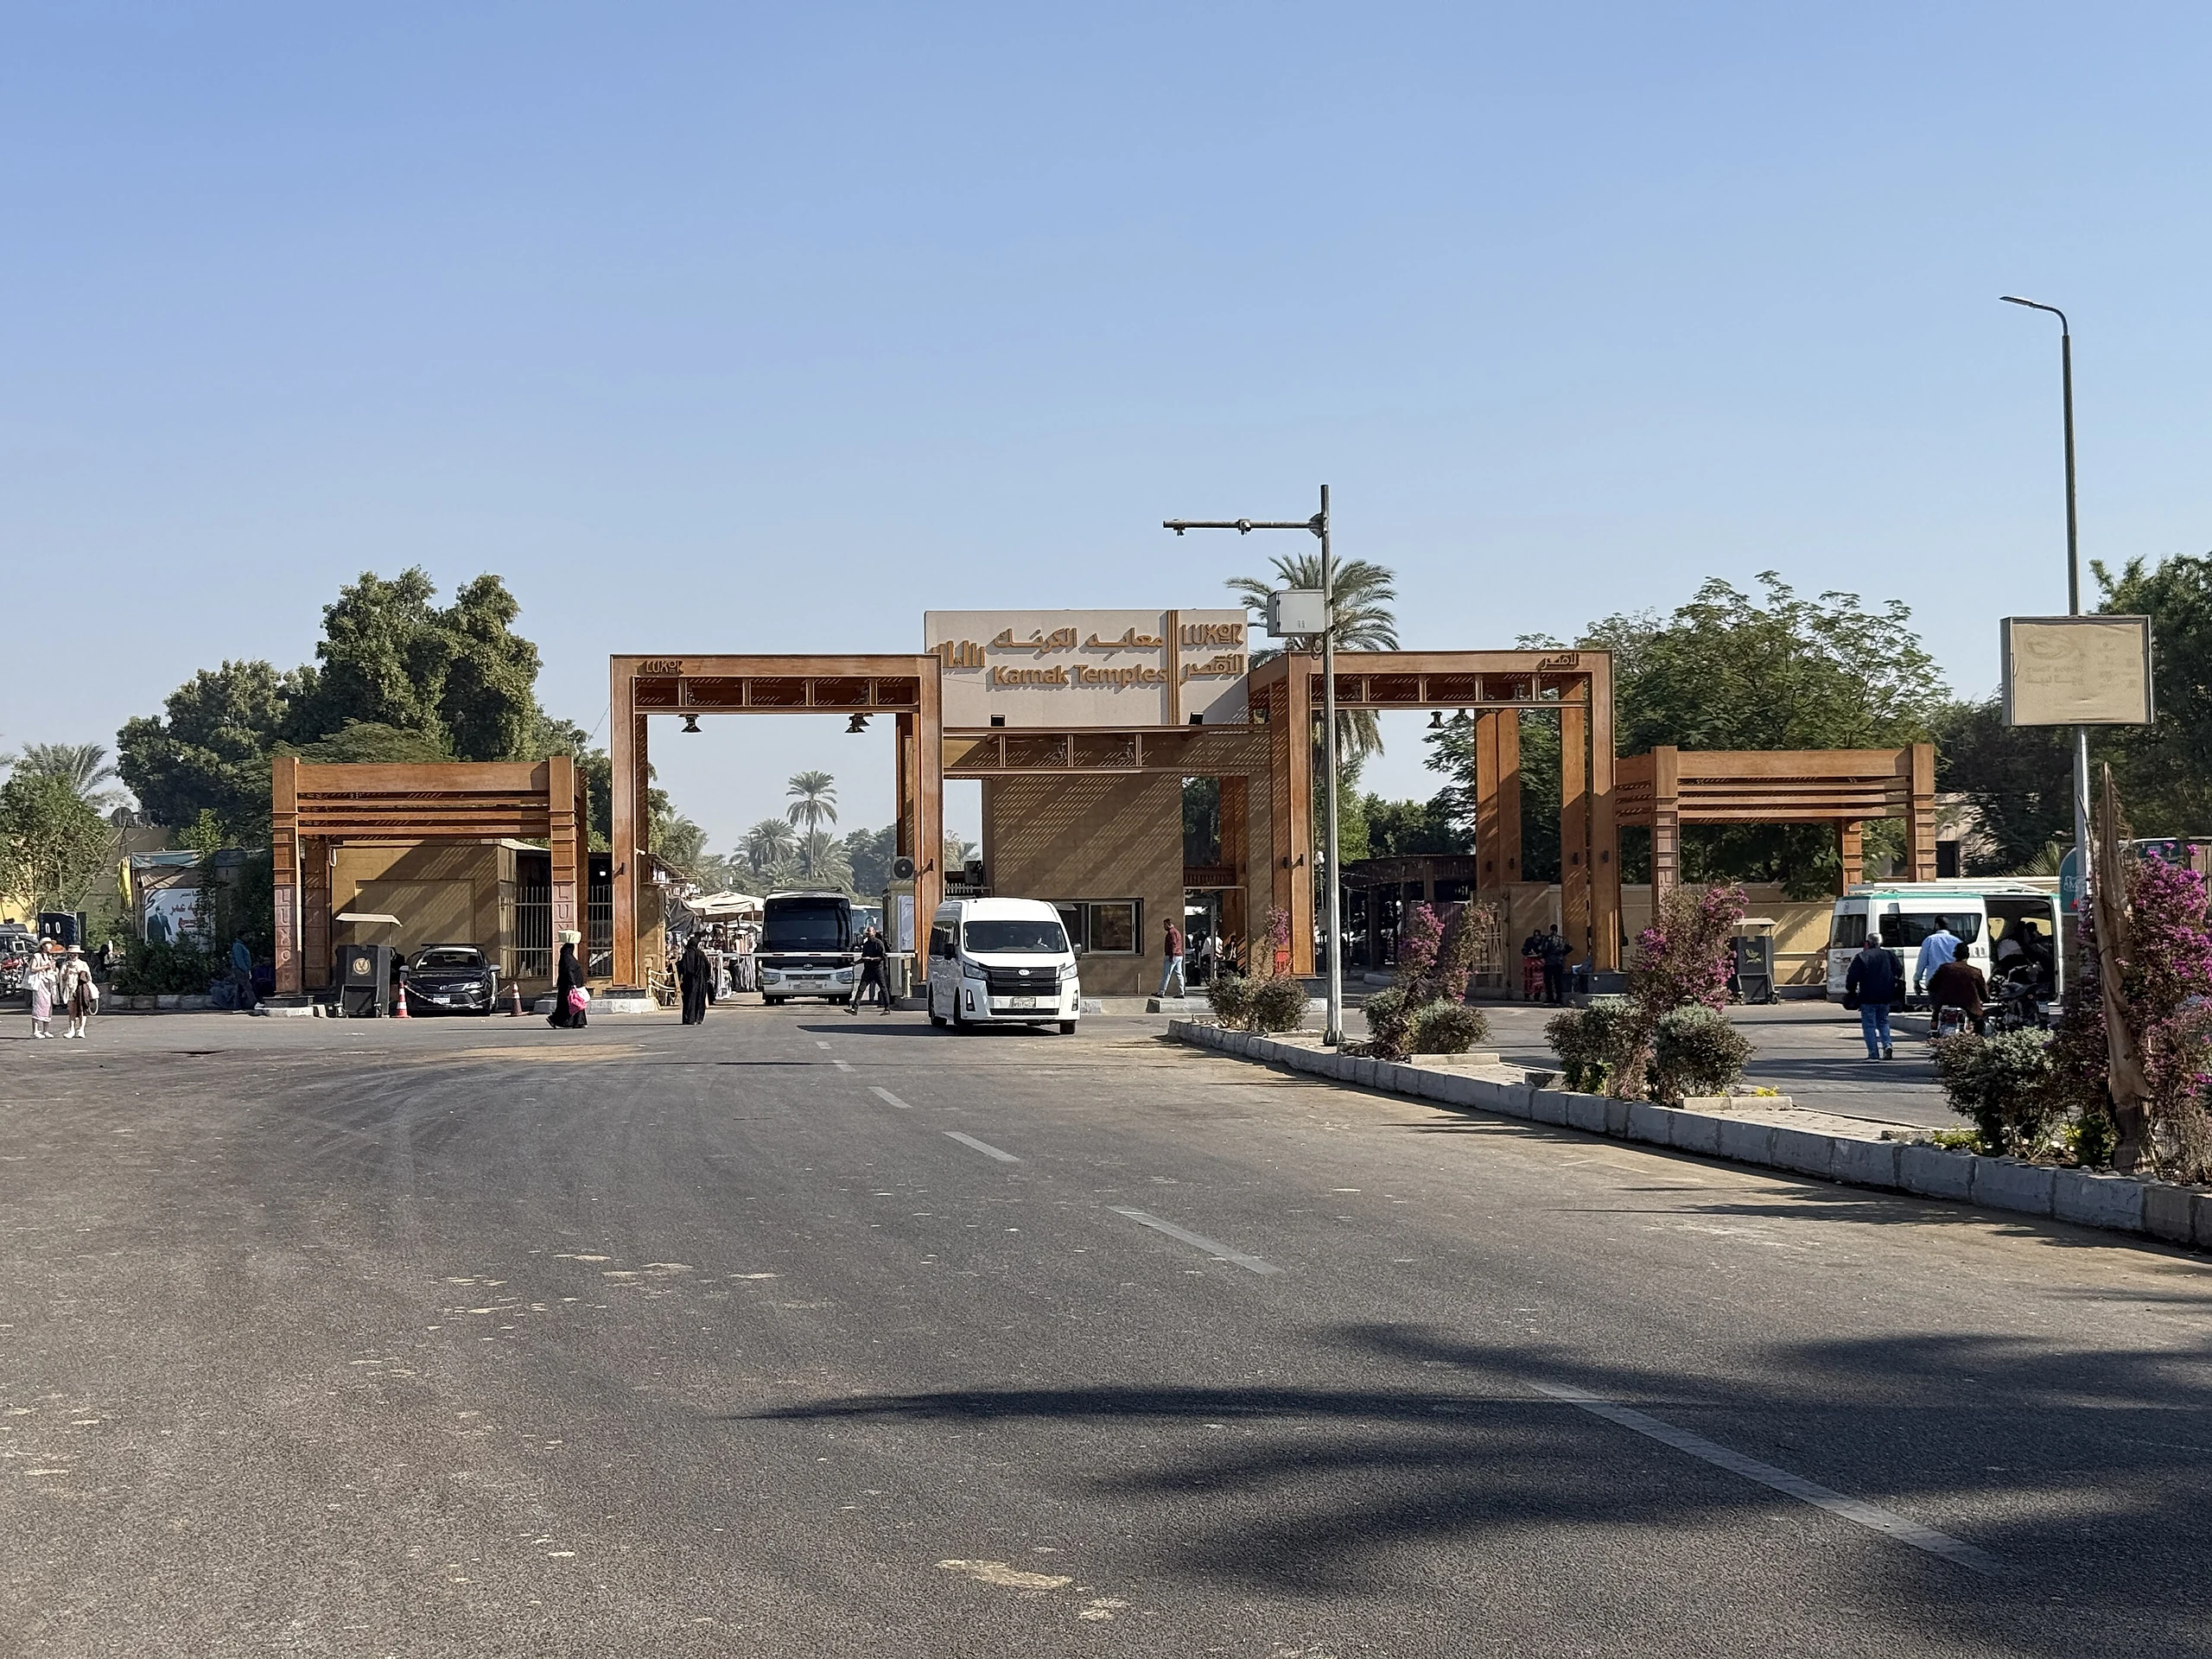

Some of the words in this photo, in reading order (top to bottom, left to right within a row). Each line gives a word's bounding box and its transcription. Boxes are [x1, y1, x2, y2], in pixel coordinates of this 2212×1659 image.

[994, 627, 1077, 654] الكرنك
[1181, 623, 1244, 645] LUXOR
[645, 659, 684, 673] LUXOR
[994, 664, 1070, 685] Karnak
[1073, 664, 1168, 689] Temples
